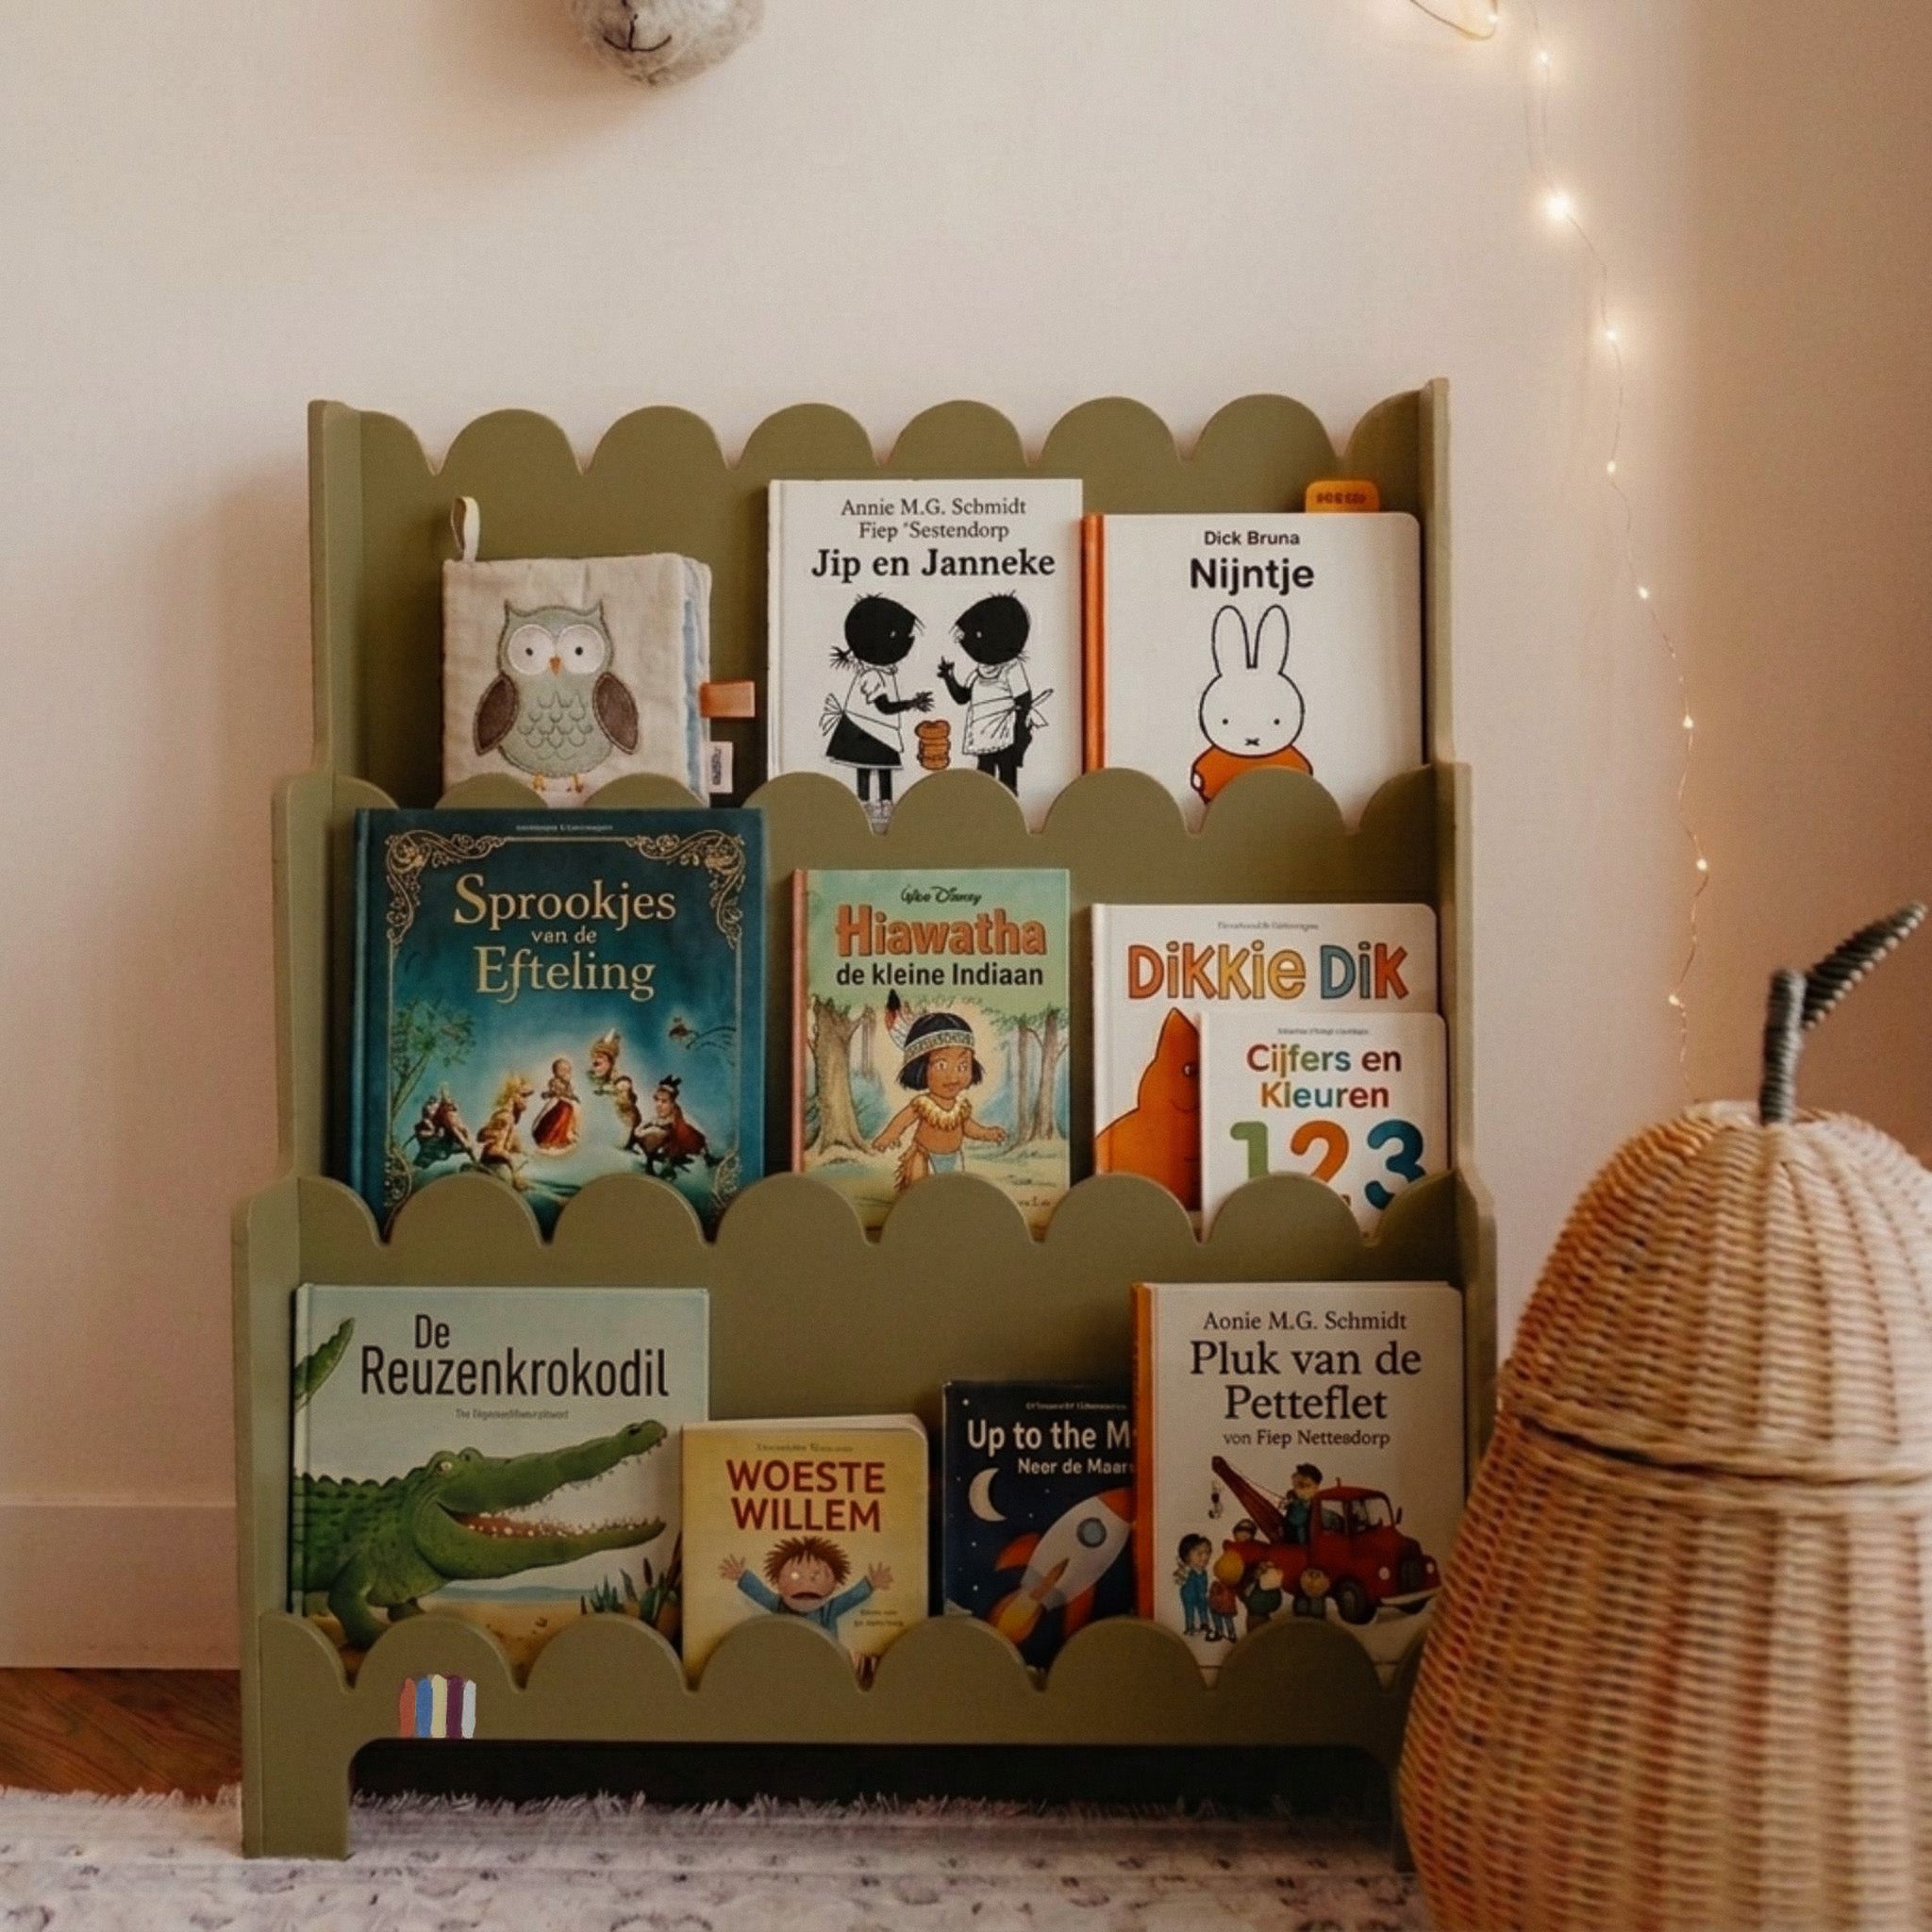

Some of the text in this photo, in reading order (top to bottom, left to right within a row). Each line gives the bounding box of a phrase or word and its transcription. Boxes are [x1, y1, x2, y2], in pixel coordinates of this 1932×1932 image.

[841, 498, 894, 516] Annie
[901, 498, 945, 516] M.G.
[859, 522, 898, 542] Fiep
[1205, 531, 1300, 545] Dick Bruna
[811, 547, 1056, 584] Jip en Janneke
[1190, 558, 1314, 596] Nijntje
[454, 874, 676, 931] Sprookjes
[575, 924, 597, 943] de
[835, 904, 1047, 958] Hiawatha
[473, 945, 657, 1005] Efteling
[836, 962, 1043, 985] de kleine Indiaan
[1246, 1043, 1402, 1078] Cijfers en
[1260, 1081, 1389, 1108] Kleuren
[415, 1314, 450, 1349] De
[1268, 1311, 1317, 1329] M.G.
[1325, 1310, 1407, 1329] Schmidt
[361, 1345, 669, 1396] Reuzenkrokodil
[1190, 1340, 1422, 1374] Pluk van de
[1224, 1384, 1388, 1420] Petteflet
[968, 1419, 1137, 1457] Up to the M
[1257, 1429, 1291, 1449] Fiep
[726, 1459, 886, 1492] WOESTE
[1062, 1457, 1082, 1474] de
[731, 1497, 880, 1532] WILLEM
